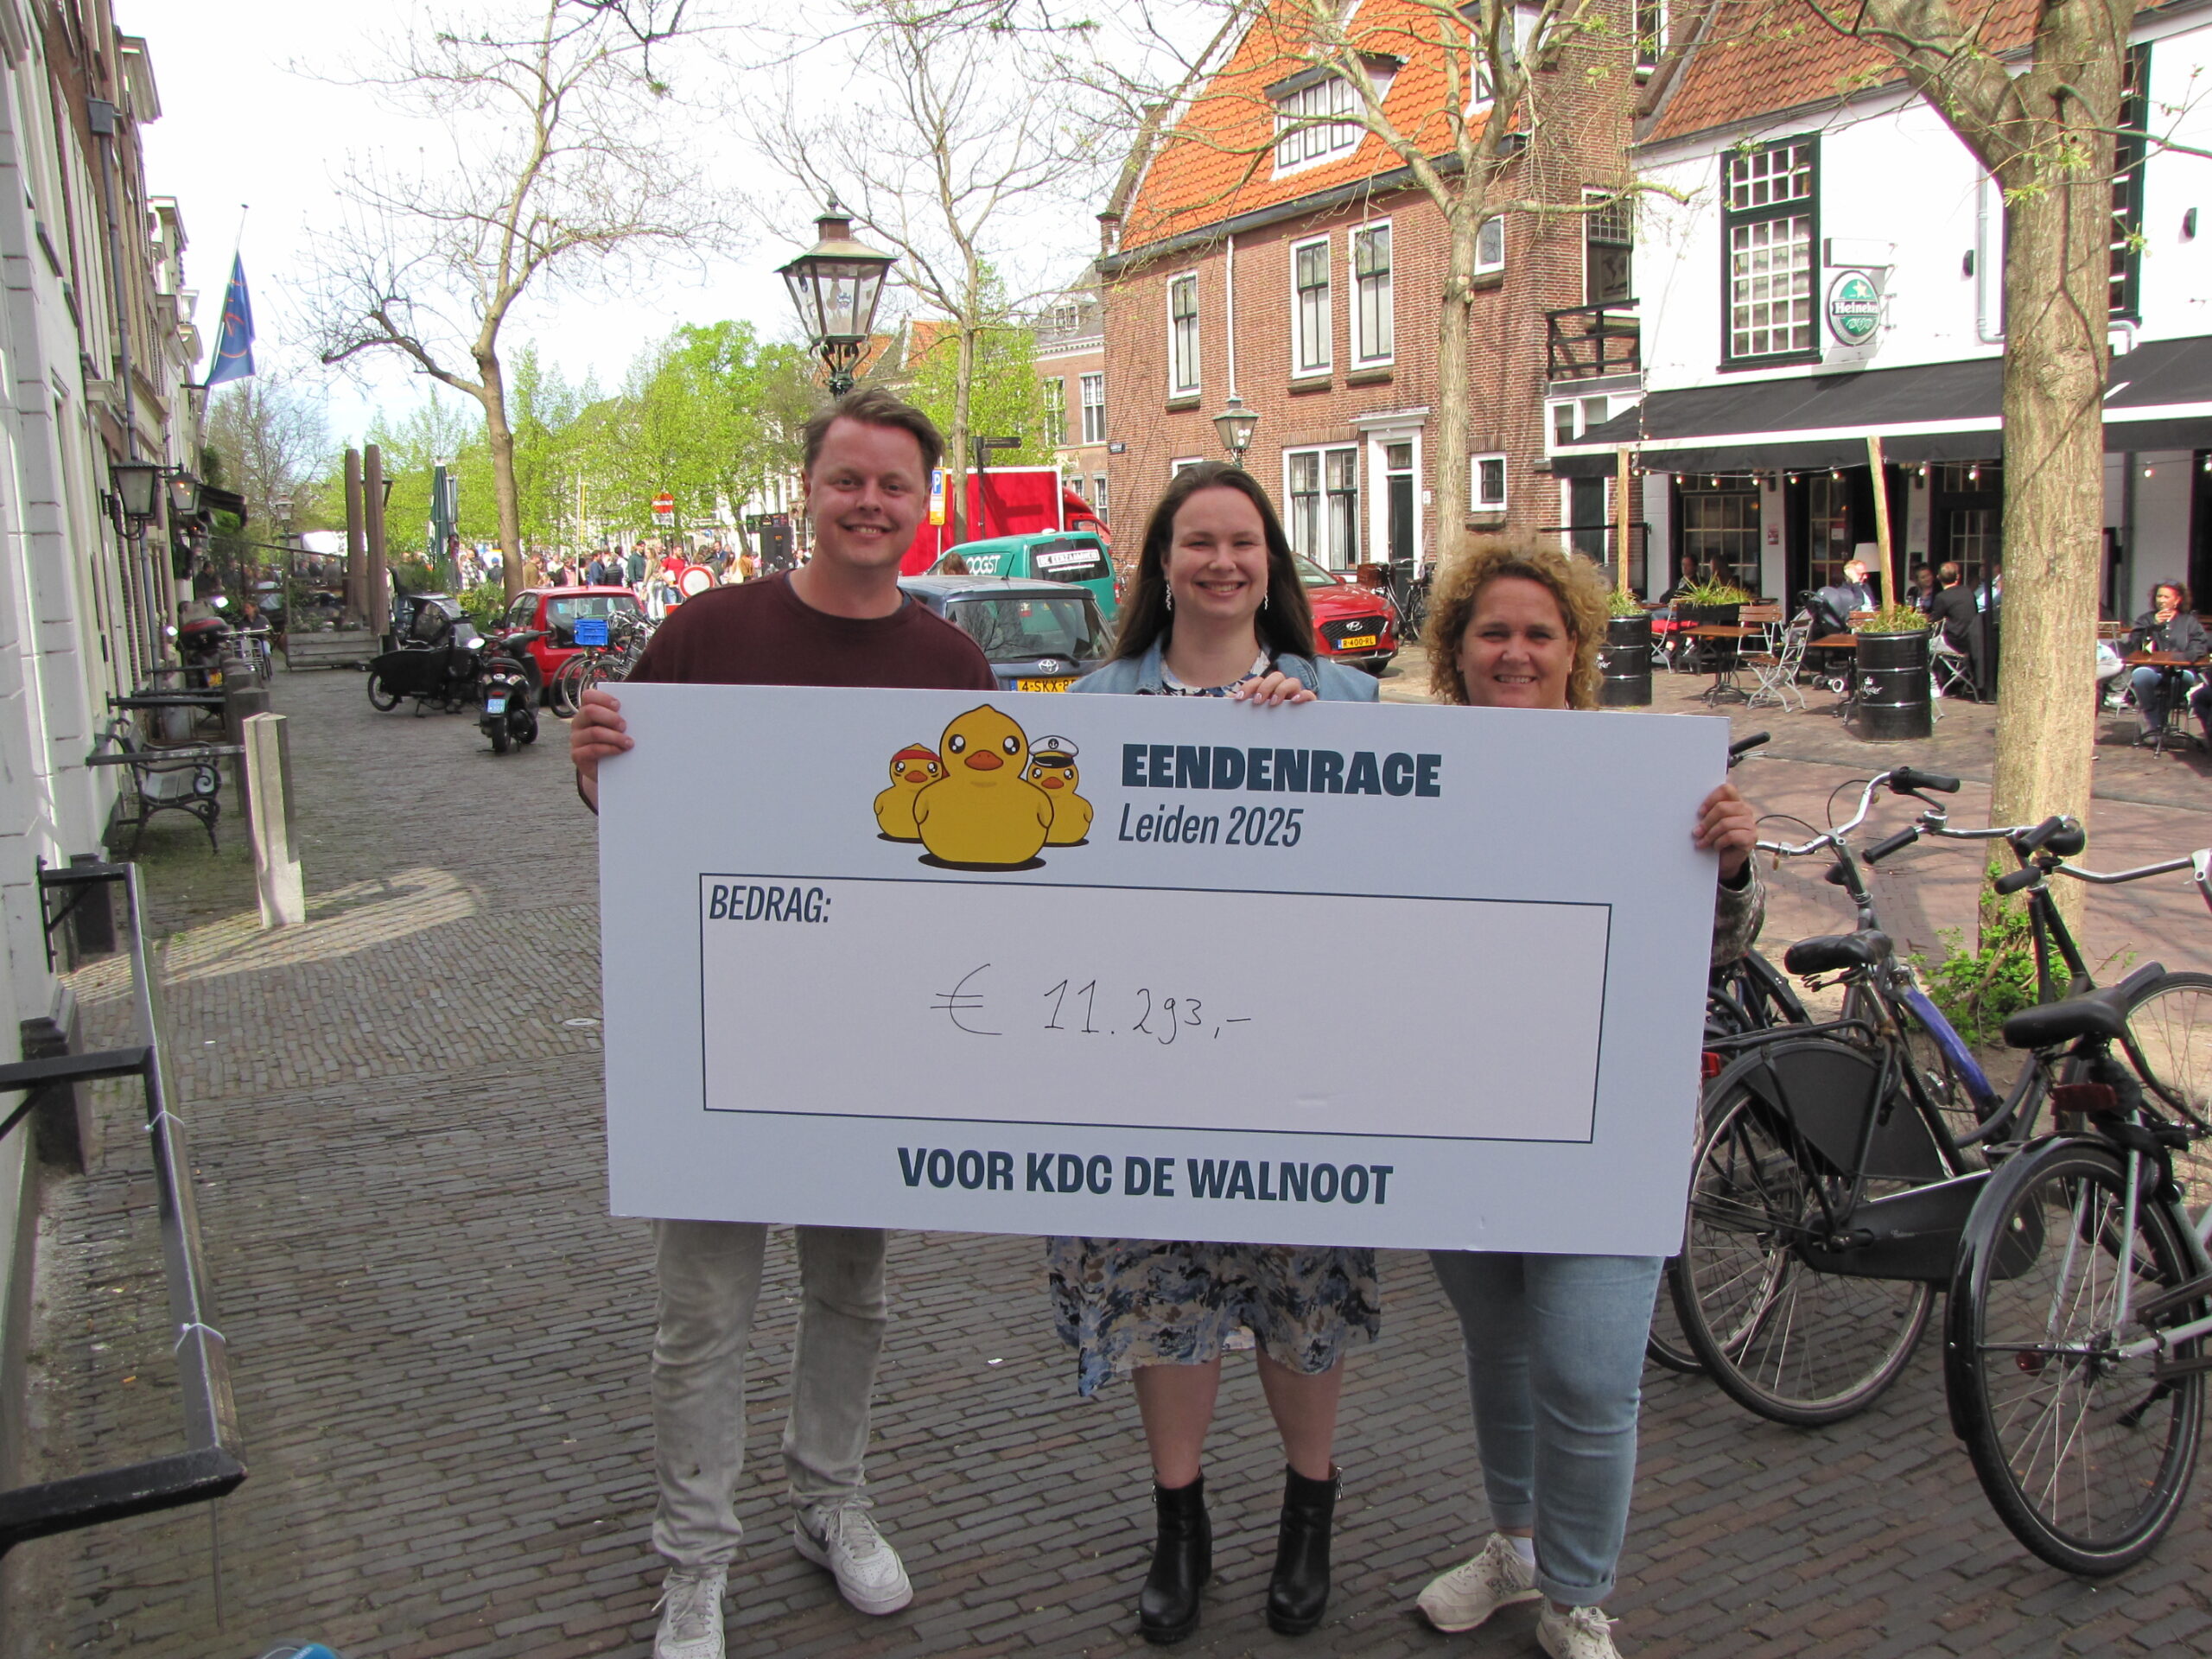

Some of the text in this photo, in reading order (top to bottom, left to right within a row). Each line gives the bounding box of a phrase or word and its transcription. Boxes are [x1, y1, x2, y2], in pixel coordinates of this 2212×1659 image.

[934, 474, 941, 493] P
[1021, 678, 1076, 692] 4-SKX-8
[1122, 743, 1442, 798] EENDENRACE
[1119, 803, 1304, 847] Leiden 2025
[709, 885, 831, 923] BEDRAG:
[930, 963, 1002, 1035] €
[897, 1147, 1394, 1205] VOOR KDC DE WALNOOT
